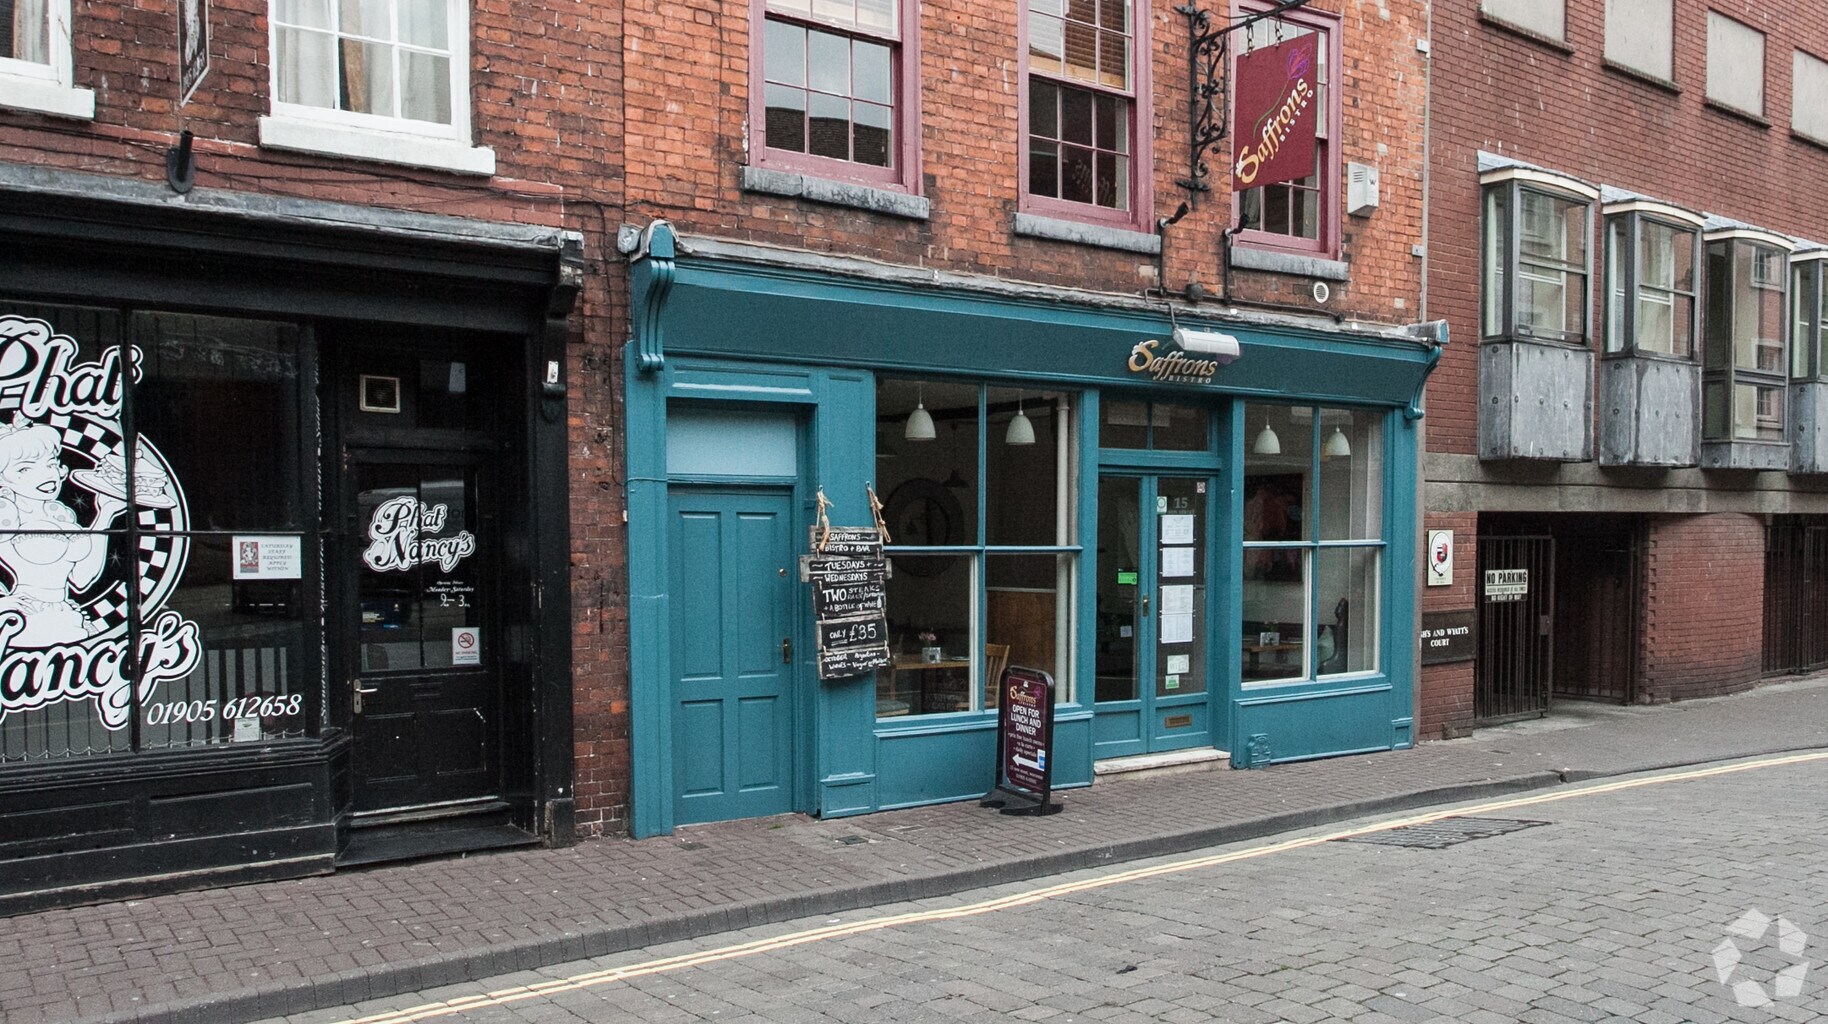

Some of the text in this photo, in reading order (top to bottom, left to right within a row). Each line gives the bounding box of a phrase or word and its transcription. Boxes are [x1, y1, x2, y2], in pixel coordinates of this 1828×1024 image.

[1279, 89, 1314, 142] BISTRO
[1235, 77, 1308, 184] Saffrons
[1127, 339, 1218, 380] Saffrons
[1168, 375, 1212, 384] BISTRO
[1174, 496, 1188, 509] 15
[370, 497, 447, 538] Phat
[829, 533, 861, 541] SAFFRONS
[365, 530, 475, 570] Nancy's
[855, 544, 871, 552] BAR
[825, 561, 865, 571] TUESDAYS
[824, 572, 868, 582] WEDNESDAYS
[1486, 571, 1527, 584] NO PARKING
[822, 588, 847, 603] TWO
[829, 623, 877, 642] ONLY £35
[1432, 629, 1445, 637] AND
[1446, 626, 1469, 636] WYATT'S
[1430, 638, 1450, 648] COURT
[1010, 685, 1037, 705] Saffrons
[147, 693, 302, 726] 01905 612658
[1012, 704, 1040, 719] OPEN FOR
[1010, 712, 1041, 729] LUNCH AND
[1015, 723, 1037, 736] DINNER
